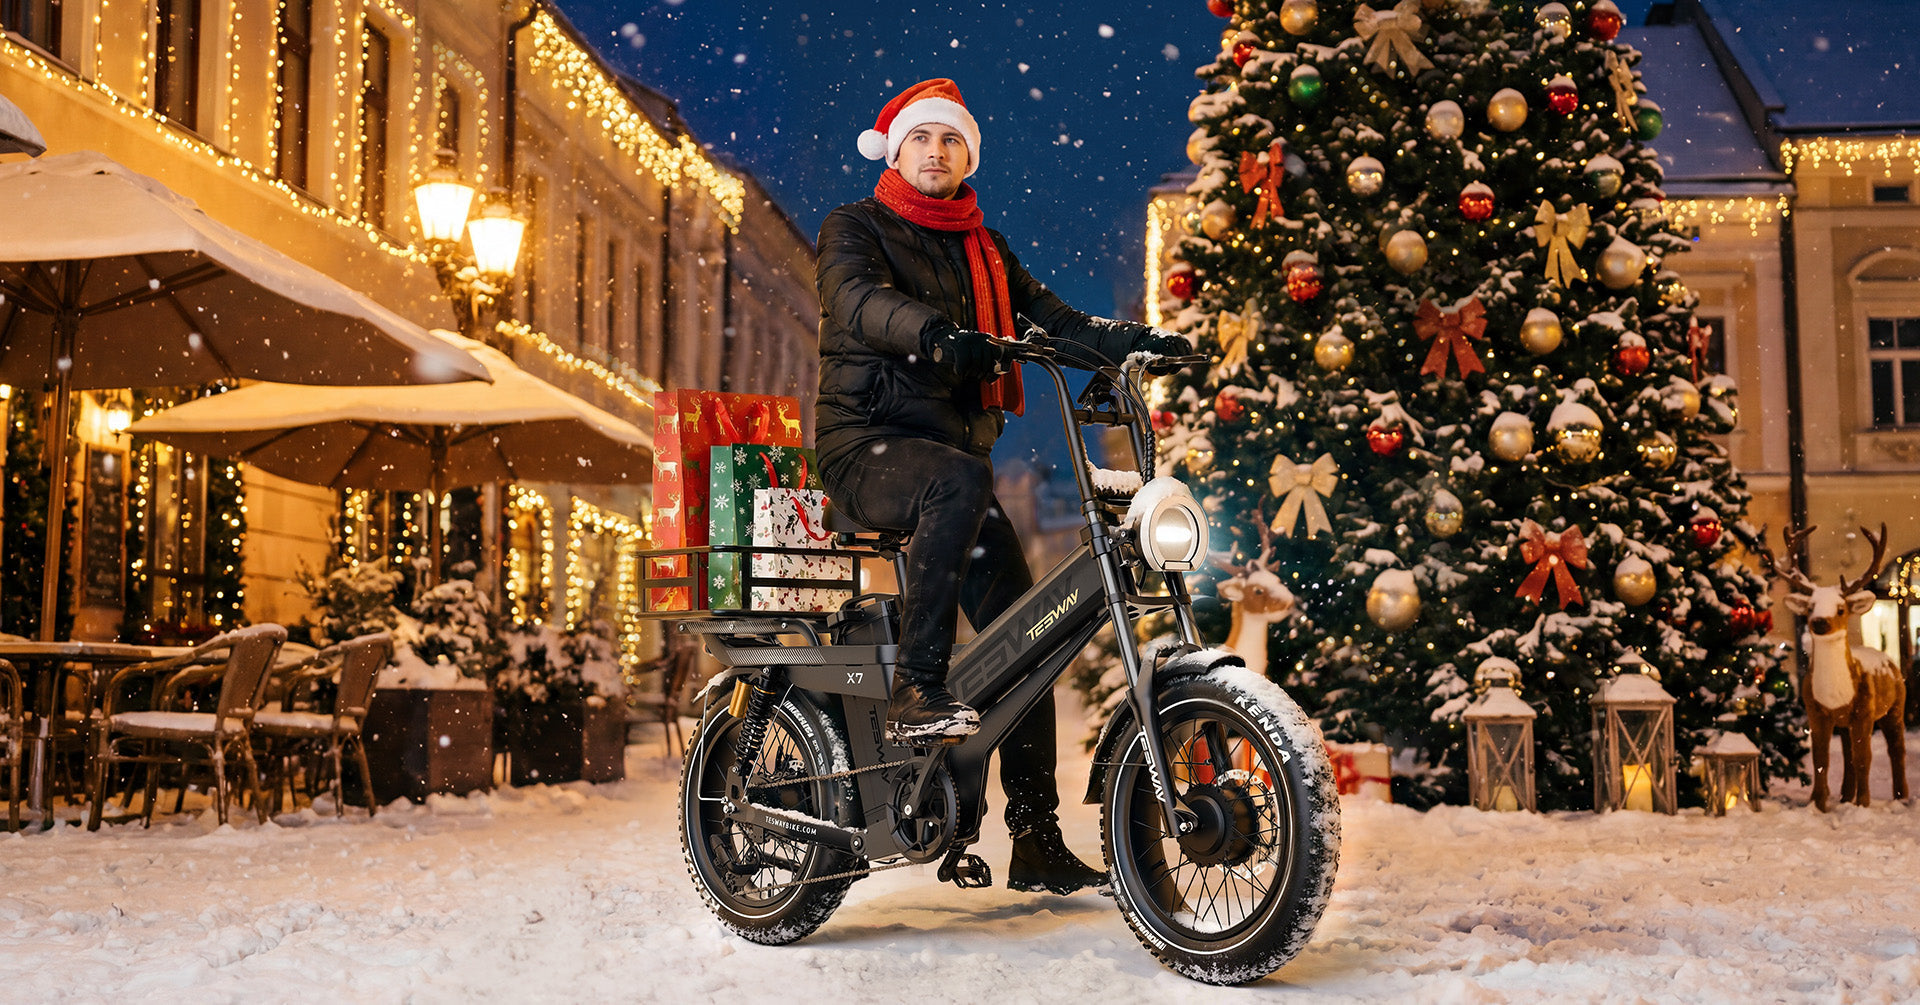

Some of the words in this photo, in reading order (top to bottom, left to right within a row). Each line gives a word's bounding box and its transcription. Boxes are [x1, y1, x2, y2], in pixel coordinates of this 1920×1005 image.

[1026, 588, 1079, 641] TESWAY
[846, 672, 863, 684] X7
[1233, 695, 1291, 765] KENDA
[1140, 725, 1167, 803] TESWAY
[765, 815, 817, 836] TESWAYBIKE.COM
